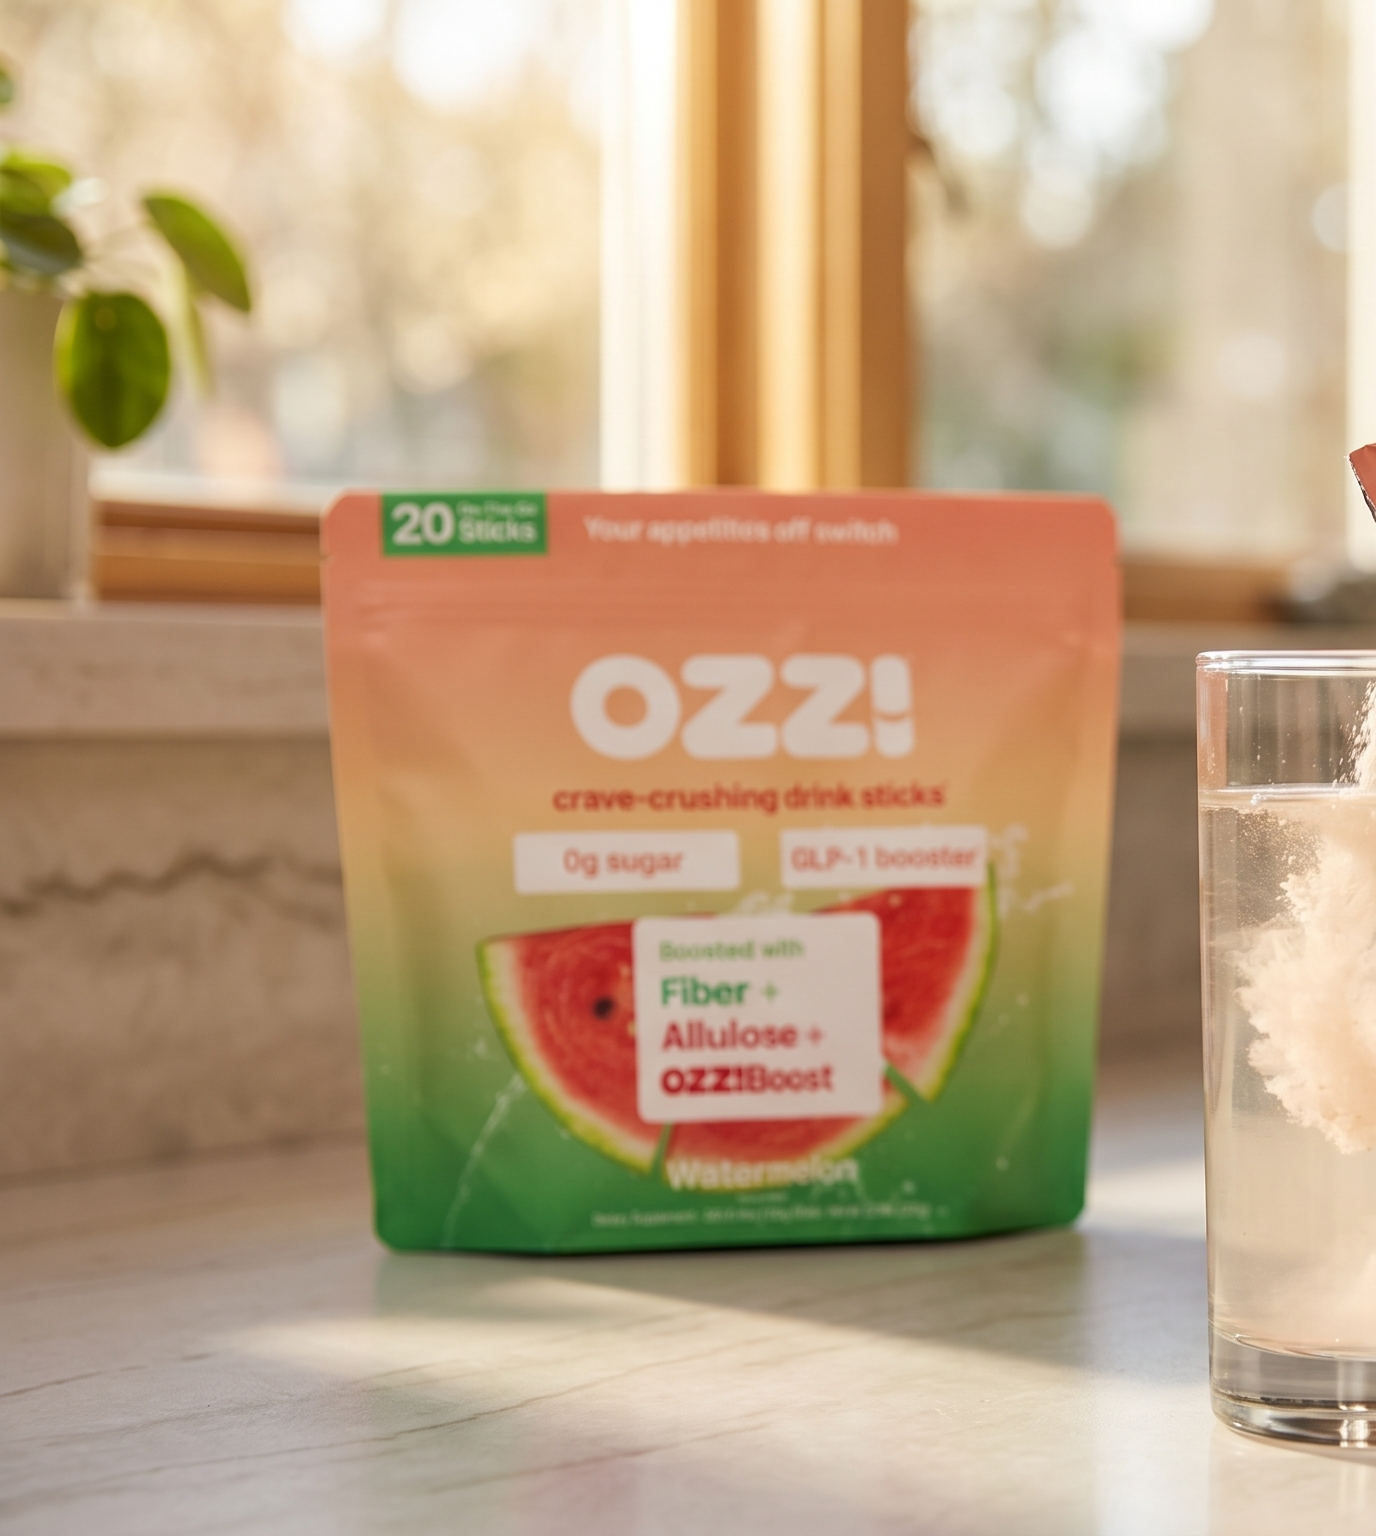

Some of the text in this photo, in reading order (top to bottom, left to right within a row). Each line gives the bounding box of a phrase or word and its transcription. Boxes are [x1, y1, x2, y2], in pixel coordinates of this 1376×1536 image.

[391, 500, 455, 546] 20
[553, 781, 778, 815] crave-crushing
[784, 782, 859, 809] drink
[563, 847, 684, 878] 0g sugar
[790, 842, 977, 872] GLP-1 booster
[660, 975, 749, 1008] Fiber
[662, 1018, 798, 1053] Allulose
[664, 1155, 859, 1191] Watermelon
